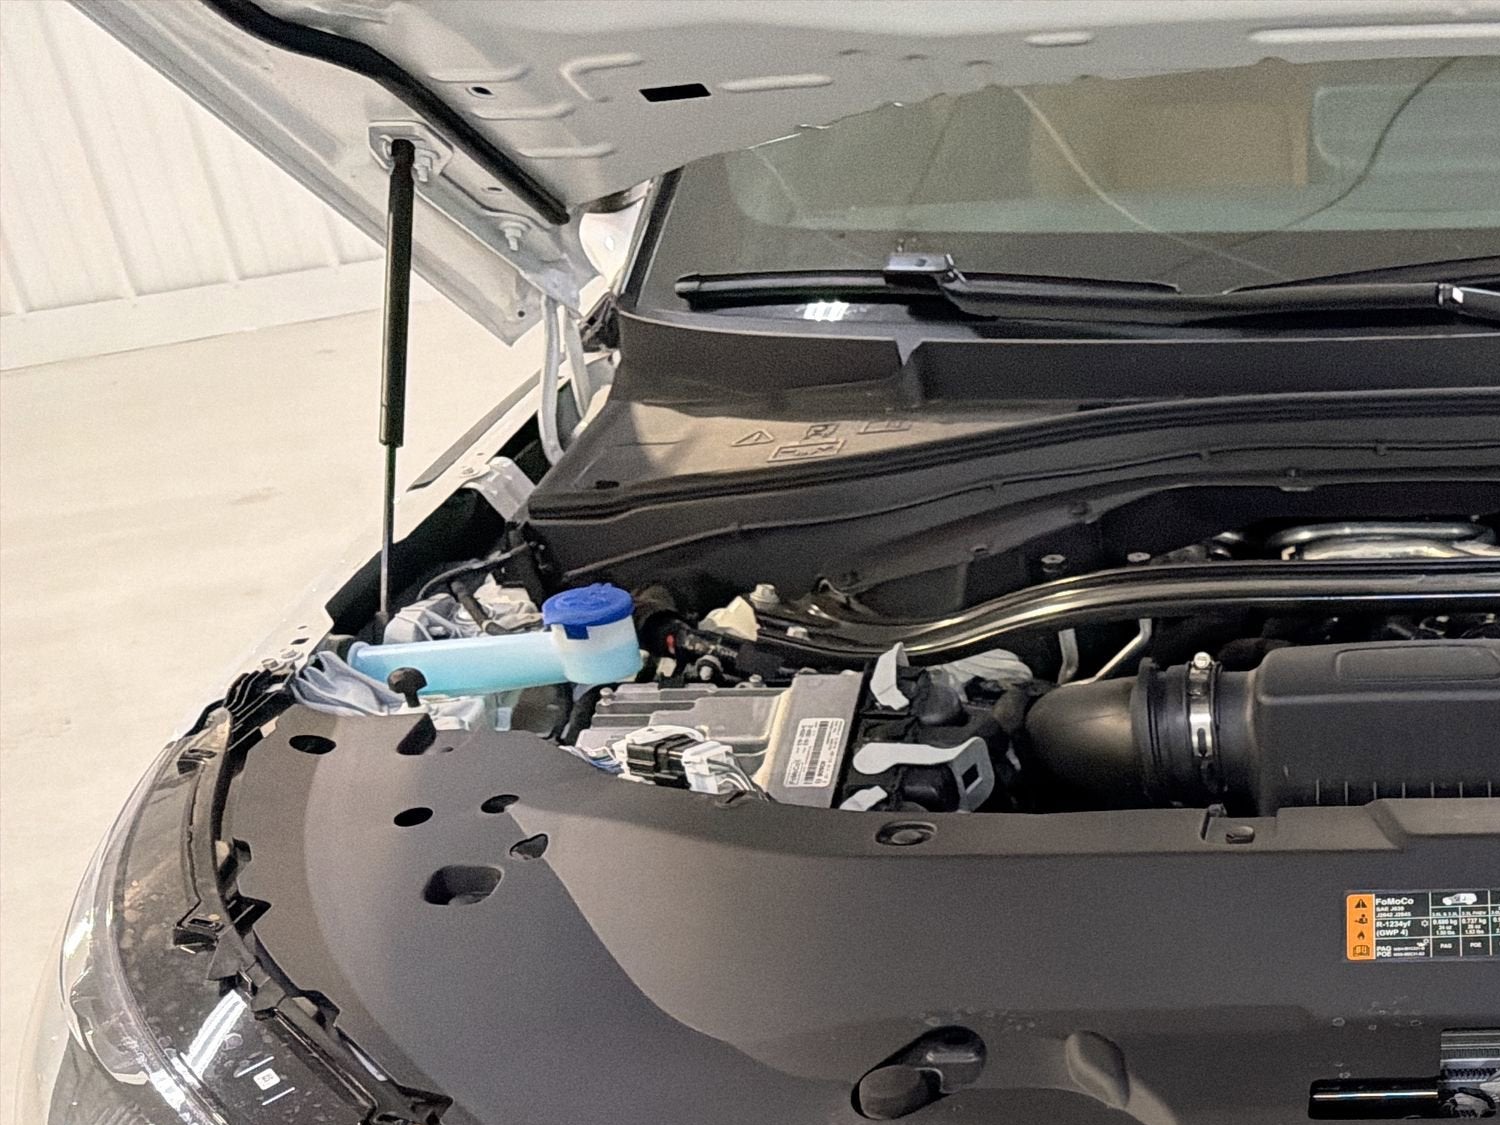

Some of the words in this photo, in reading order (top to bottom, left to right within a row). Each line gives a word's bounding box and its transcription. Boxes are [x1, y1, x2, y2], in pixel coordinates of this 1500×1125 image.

[1375, 897, 1414, 906] FoMoCo
[1376, 920, 1411, 928] R-1234yf
[1478, 917, 1487, 925] kg
[1376, 929, 1399, 937] (GWP
[1400, 928, 1409, 937] 4)
